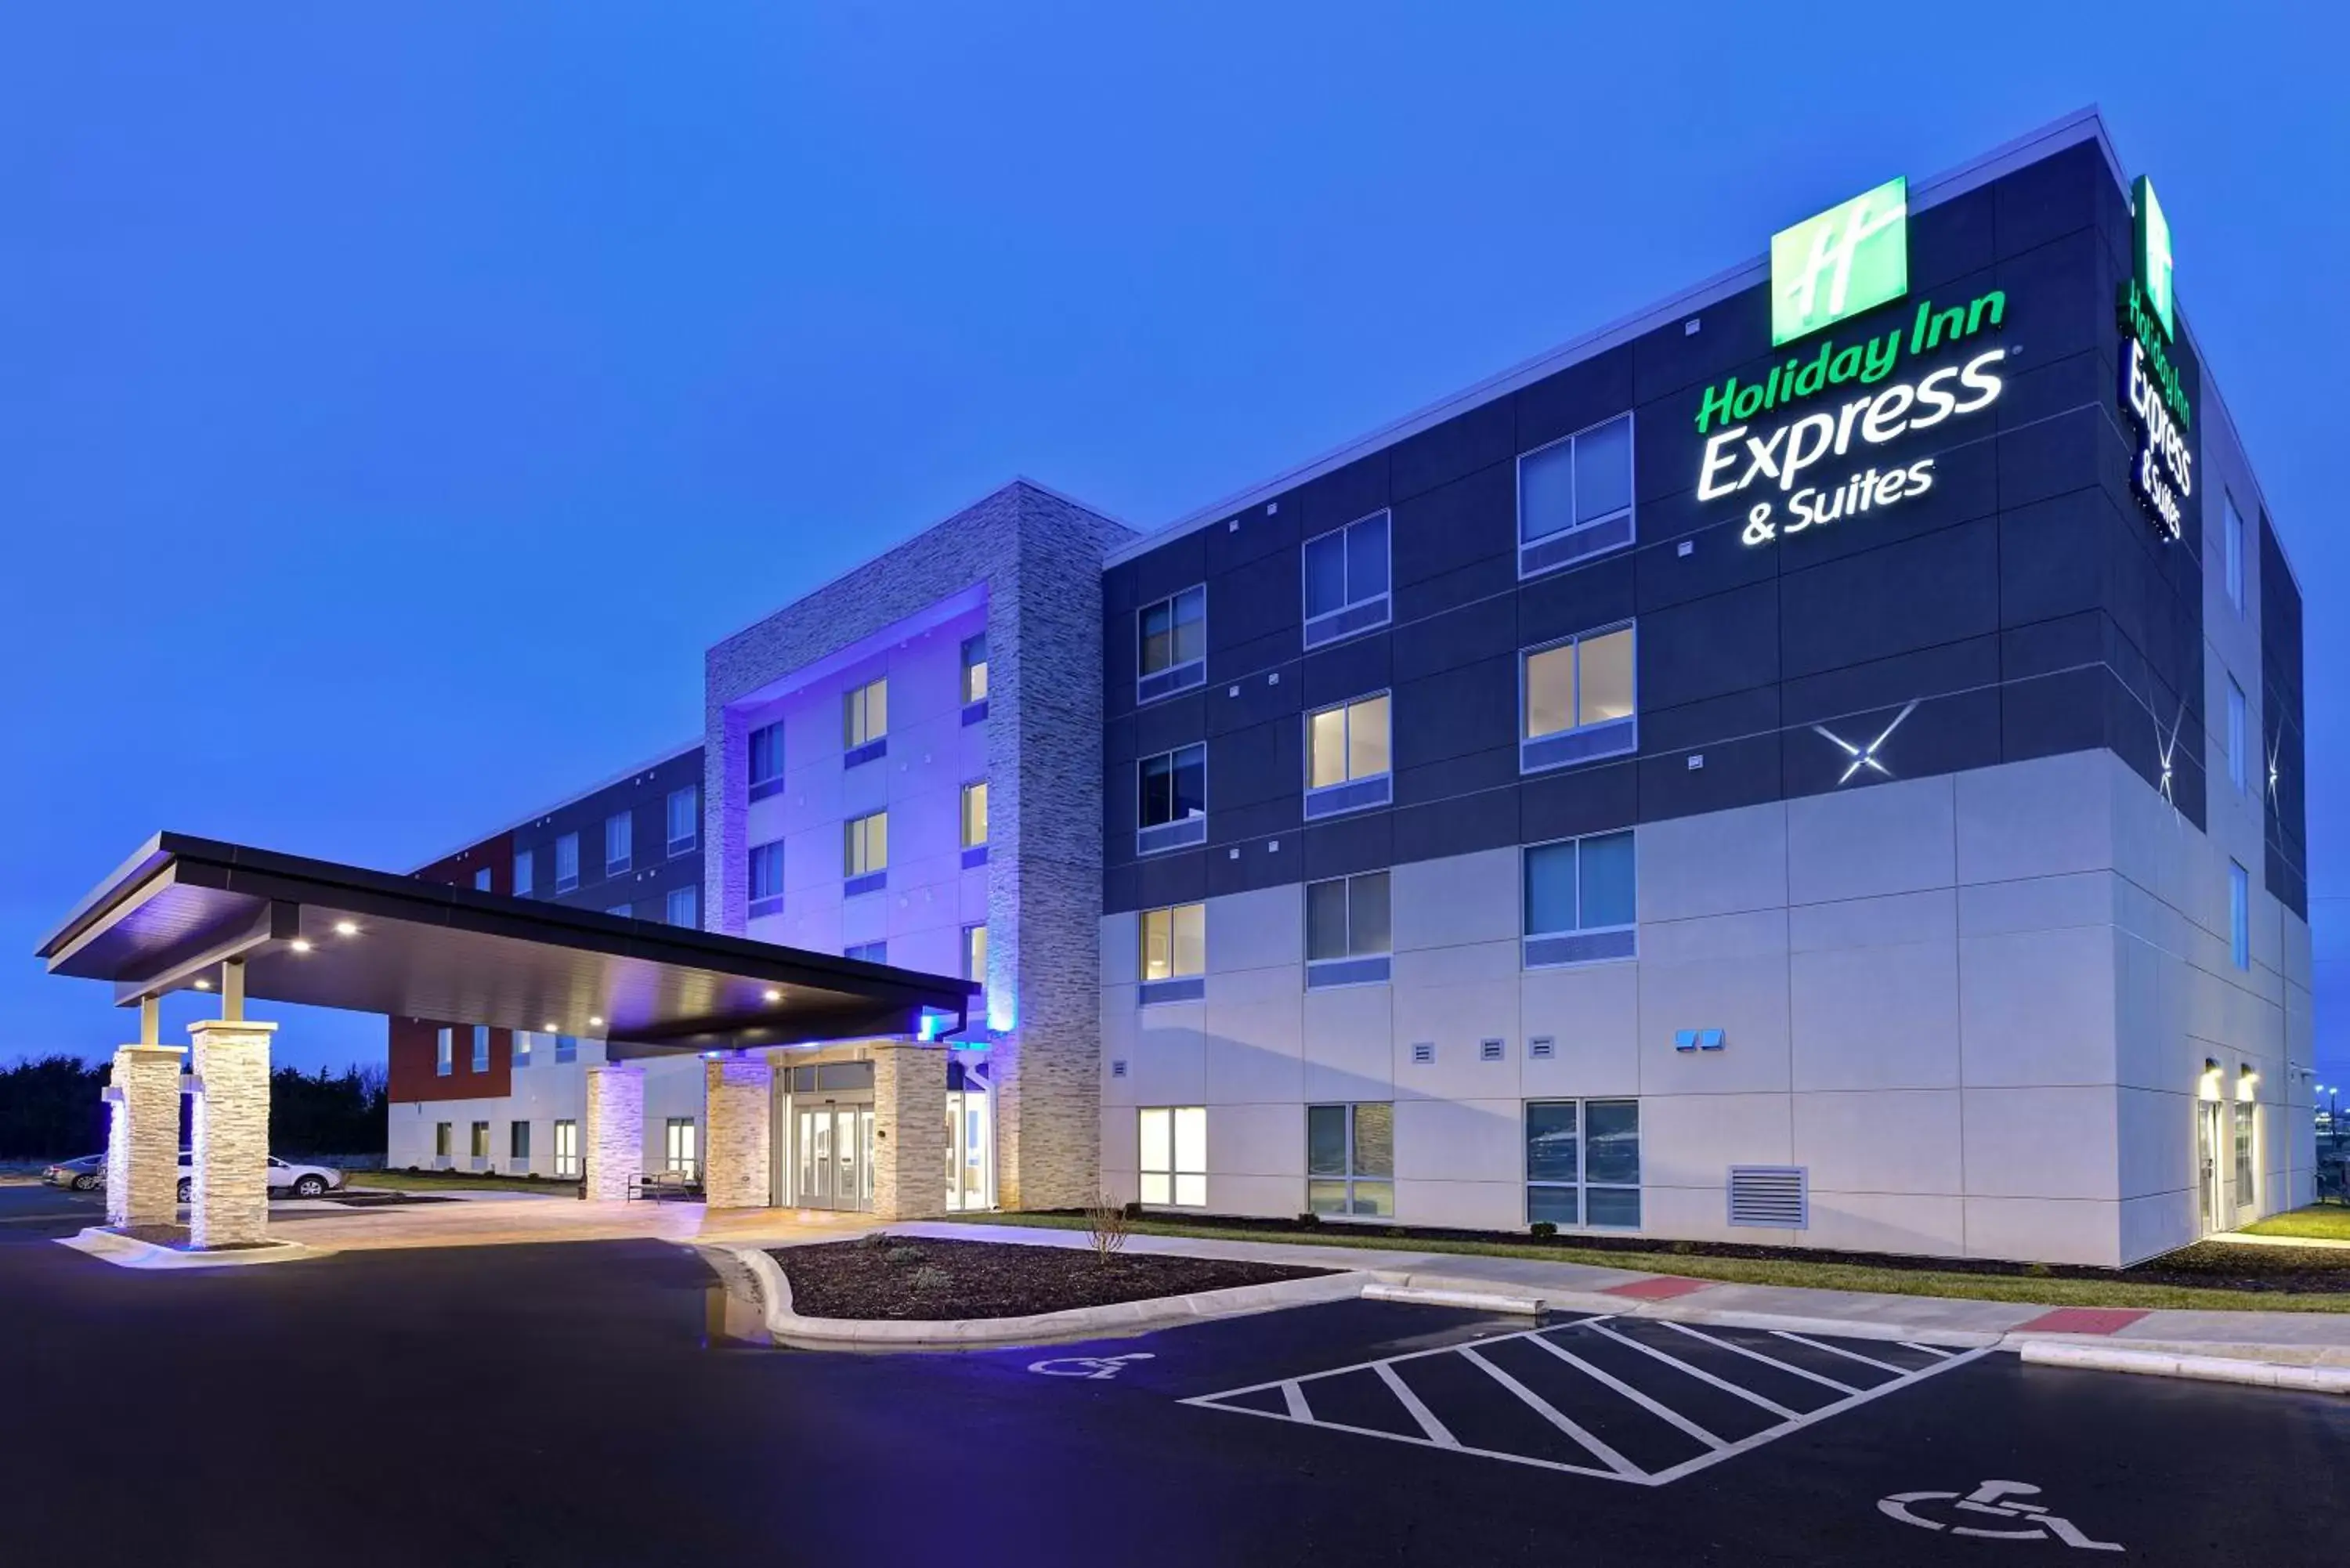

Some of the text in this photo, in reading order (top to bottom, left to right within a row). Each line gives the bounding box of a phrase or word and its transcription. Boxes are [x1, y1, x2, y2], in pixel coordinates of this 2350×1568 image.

[1696, 349, 2005, 503] Express
[1697, 290, 2006, 434] Holiday Inn
[2130, 279, 2174, 403] Holiday
[2175, 367, 2190, 429] Inn
[2130, 338, 2191, 498] Express
[1741, 459, 1935, 547] & Suites
[2142, 449, 2182, 540] & Suites
